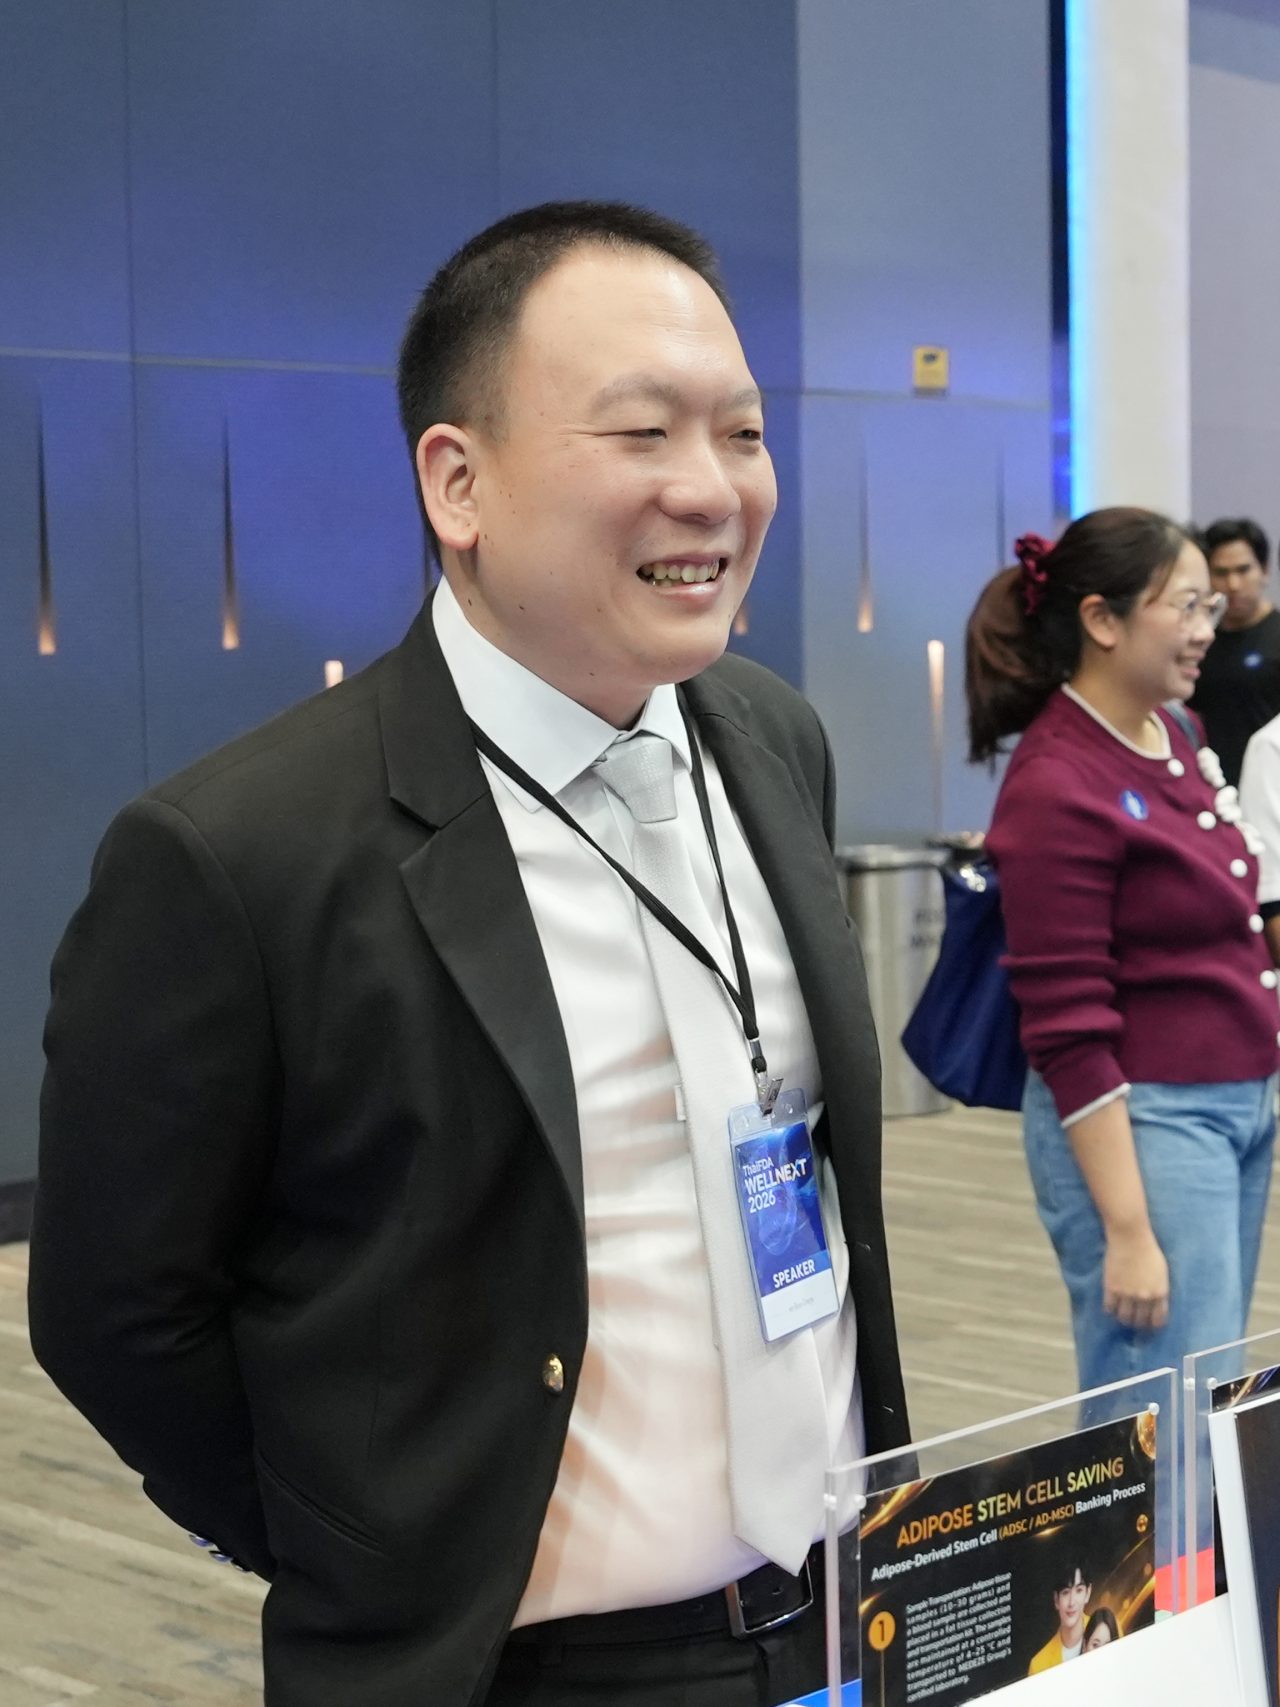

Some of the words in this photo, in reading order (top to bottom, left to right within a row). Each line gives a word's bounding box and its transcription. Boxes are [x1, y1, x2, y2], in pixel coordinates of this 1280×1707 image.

[743, 1157, 774, 1176] ThaiFDA
[744, 1158, 807, 1195] WELLNEXT
[748, 1189, 776, 1213] 2026
[772, 1259, 816, 1288] SPEAKER
[897, 1505, 974, 1548] ADIPOSE
[977, 1490, 1021, 1522] STEM
[1026, 1477, 1063, 1505] CELL
[1067, 1457, 1124, 1492] SAVING
[871, 1543, 952, 1582] Adipose-Derived
[954, 1537, 978, 1554] Stem
[980, 1528, 998, 1546] Cell
[999, 1518, 1028, 1541] (ADSC
[1035, 1504, 1074, 1528] AD-MSC)
[1076, 1492, 1112, 1514] Banking
[1113, 1482, 1146, 1500] Process
[996, 1581, 1010, 1593] and
[878, 1619, 887, 1642] 1
